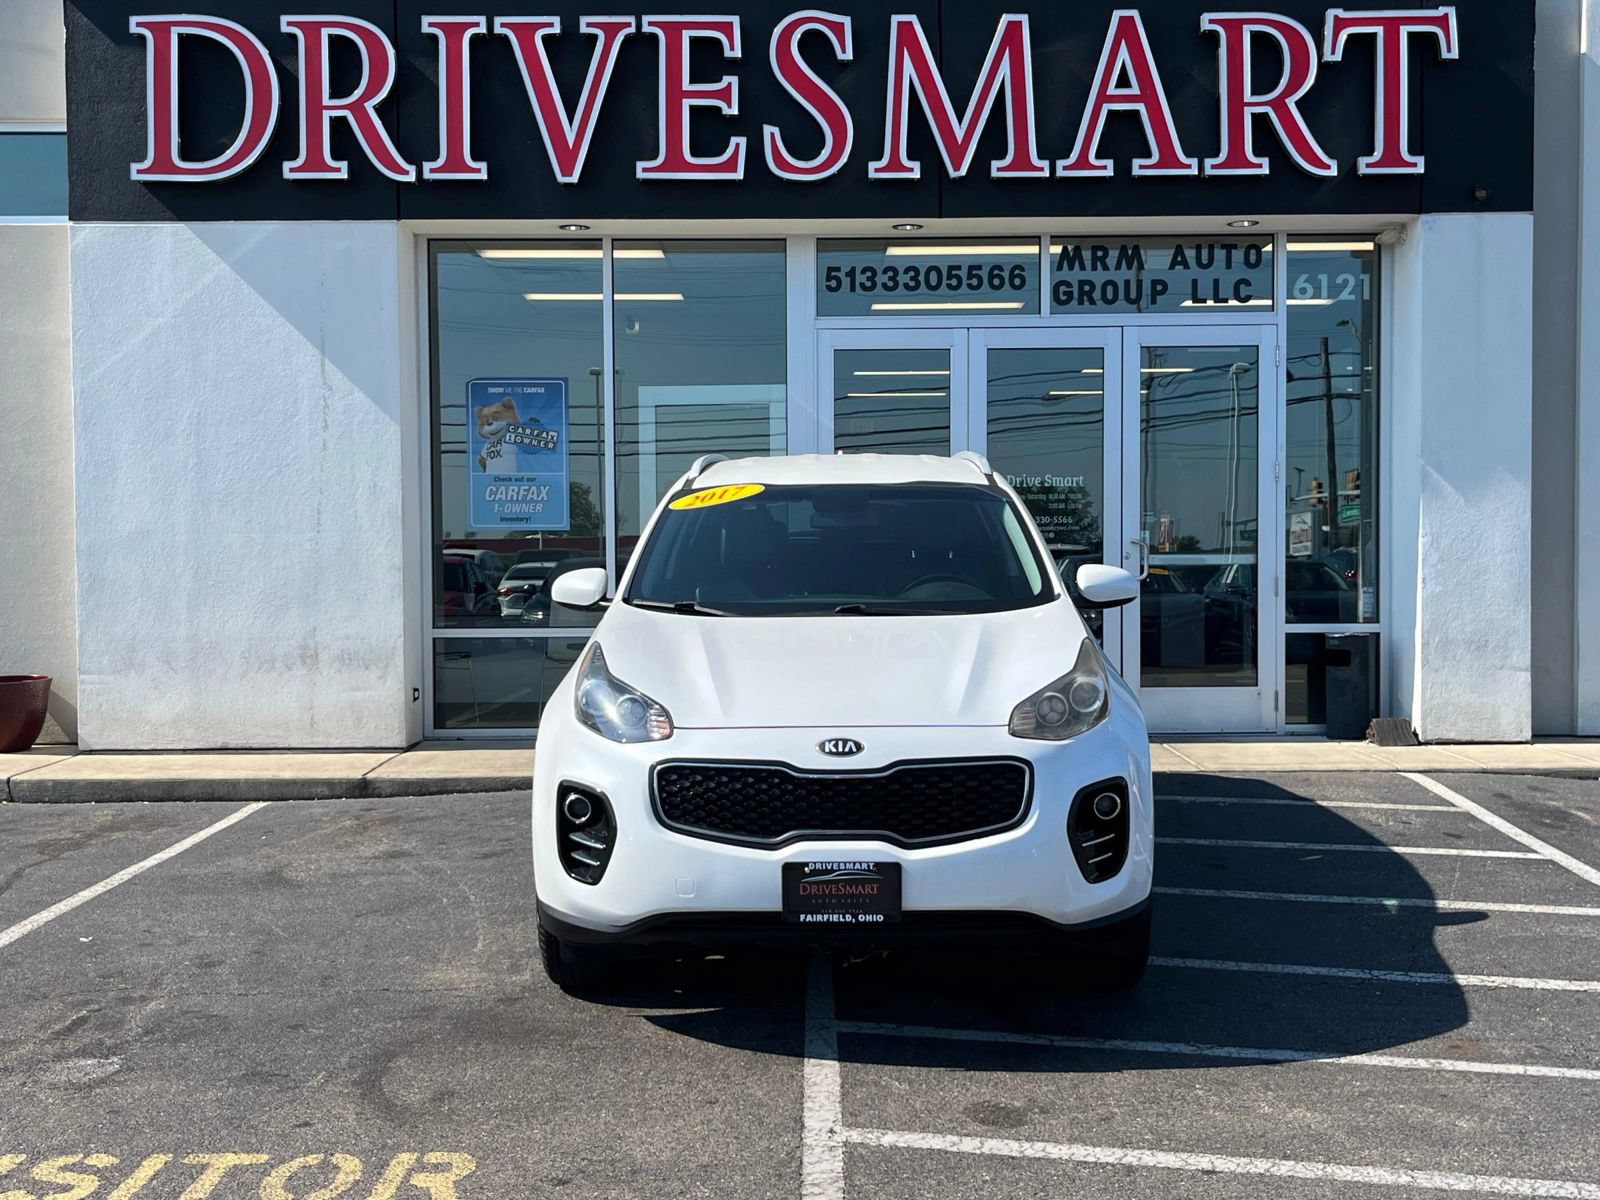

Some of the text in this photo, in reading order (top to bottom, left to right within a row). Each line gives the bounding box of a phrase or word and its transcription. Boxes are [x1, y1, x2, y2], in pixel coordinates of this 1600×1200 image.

[129, 6, 1460, 186] DRIVESMART
[1055, 243, 1264, 272] MRM AUTO
[824, 264, 1027, 293] 5133305566
[1293, 273, 1370, 300] 6121
[1052, 277, 1253, 306] GROUP LLC
[509, 425, 558, 440] CARFAX
[1007, 474, 1085, 487] Drive Smart
[485, 485, 550, 501] CARFAX
[685, 486, 746, 507] 2017
[824, 740, 857, 753] KIA
[809, 862, 875, 870] DRIVESMART
[800, 914, 884, 923] FAIRFIELD, OHIO
